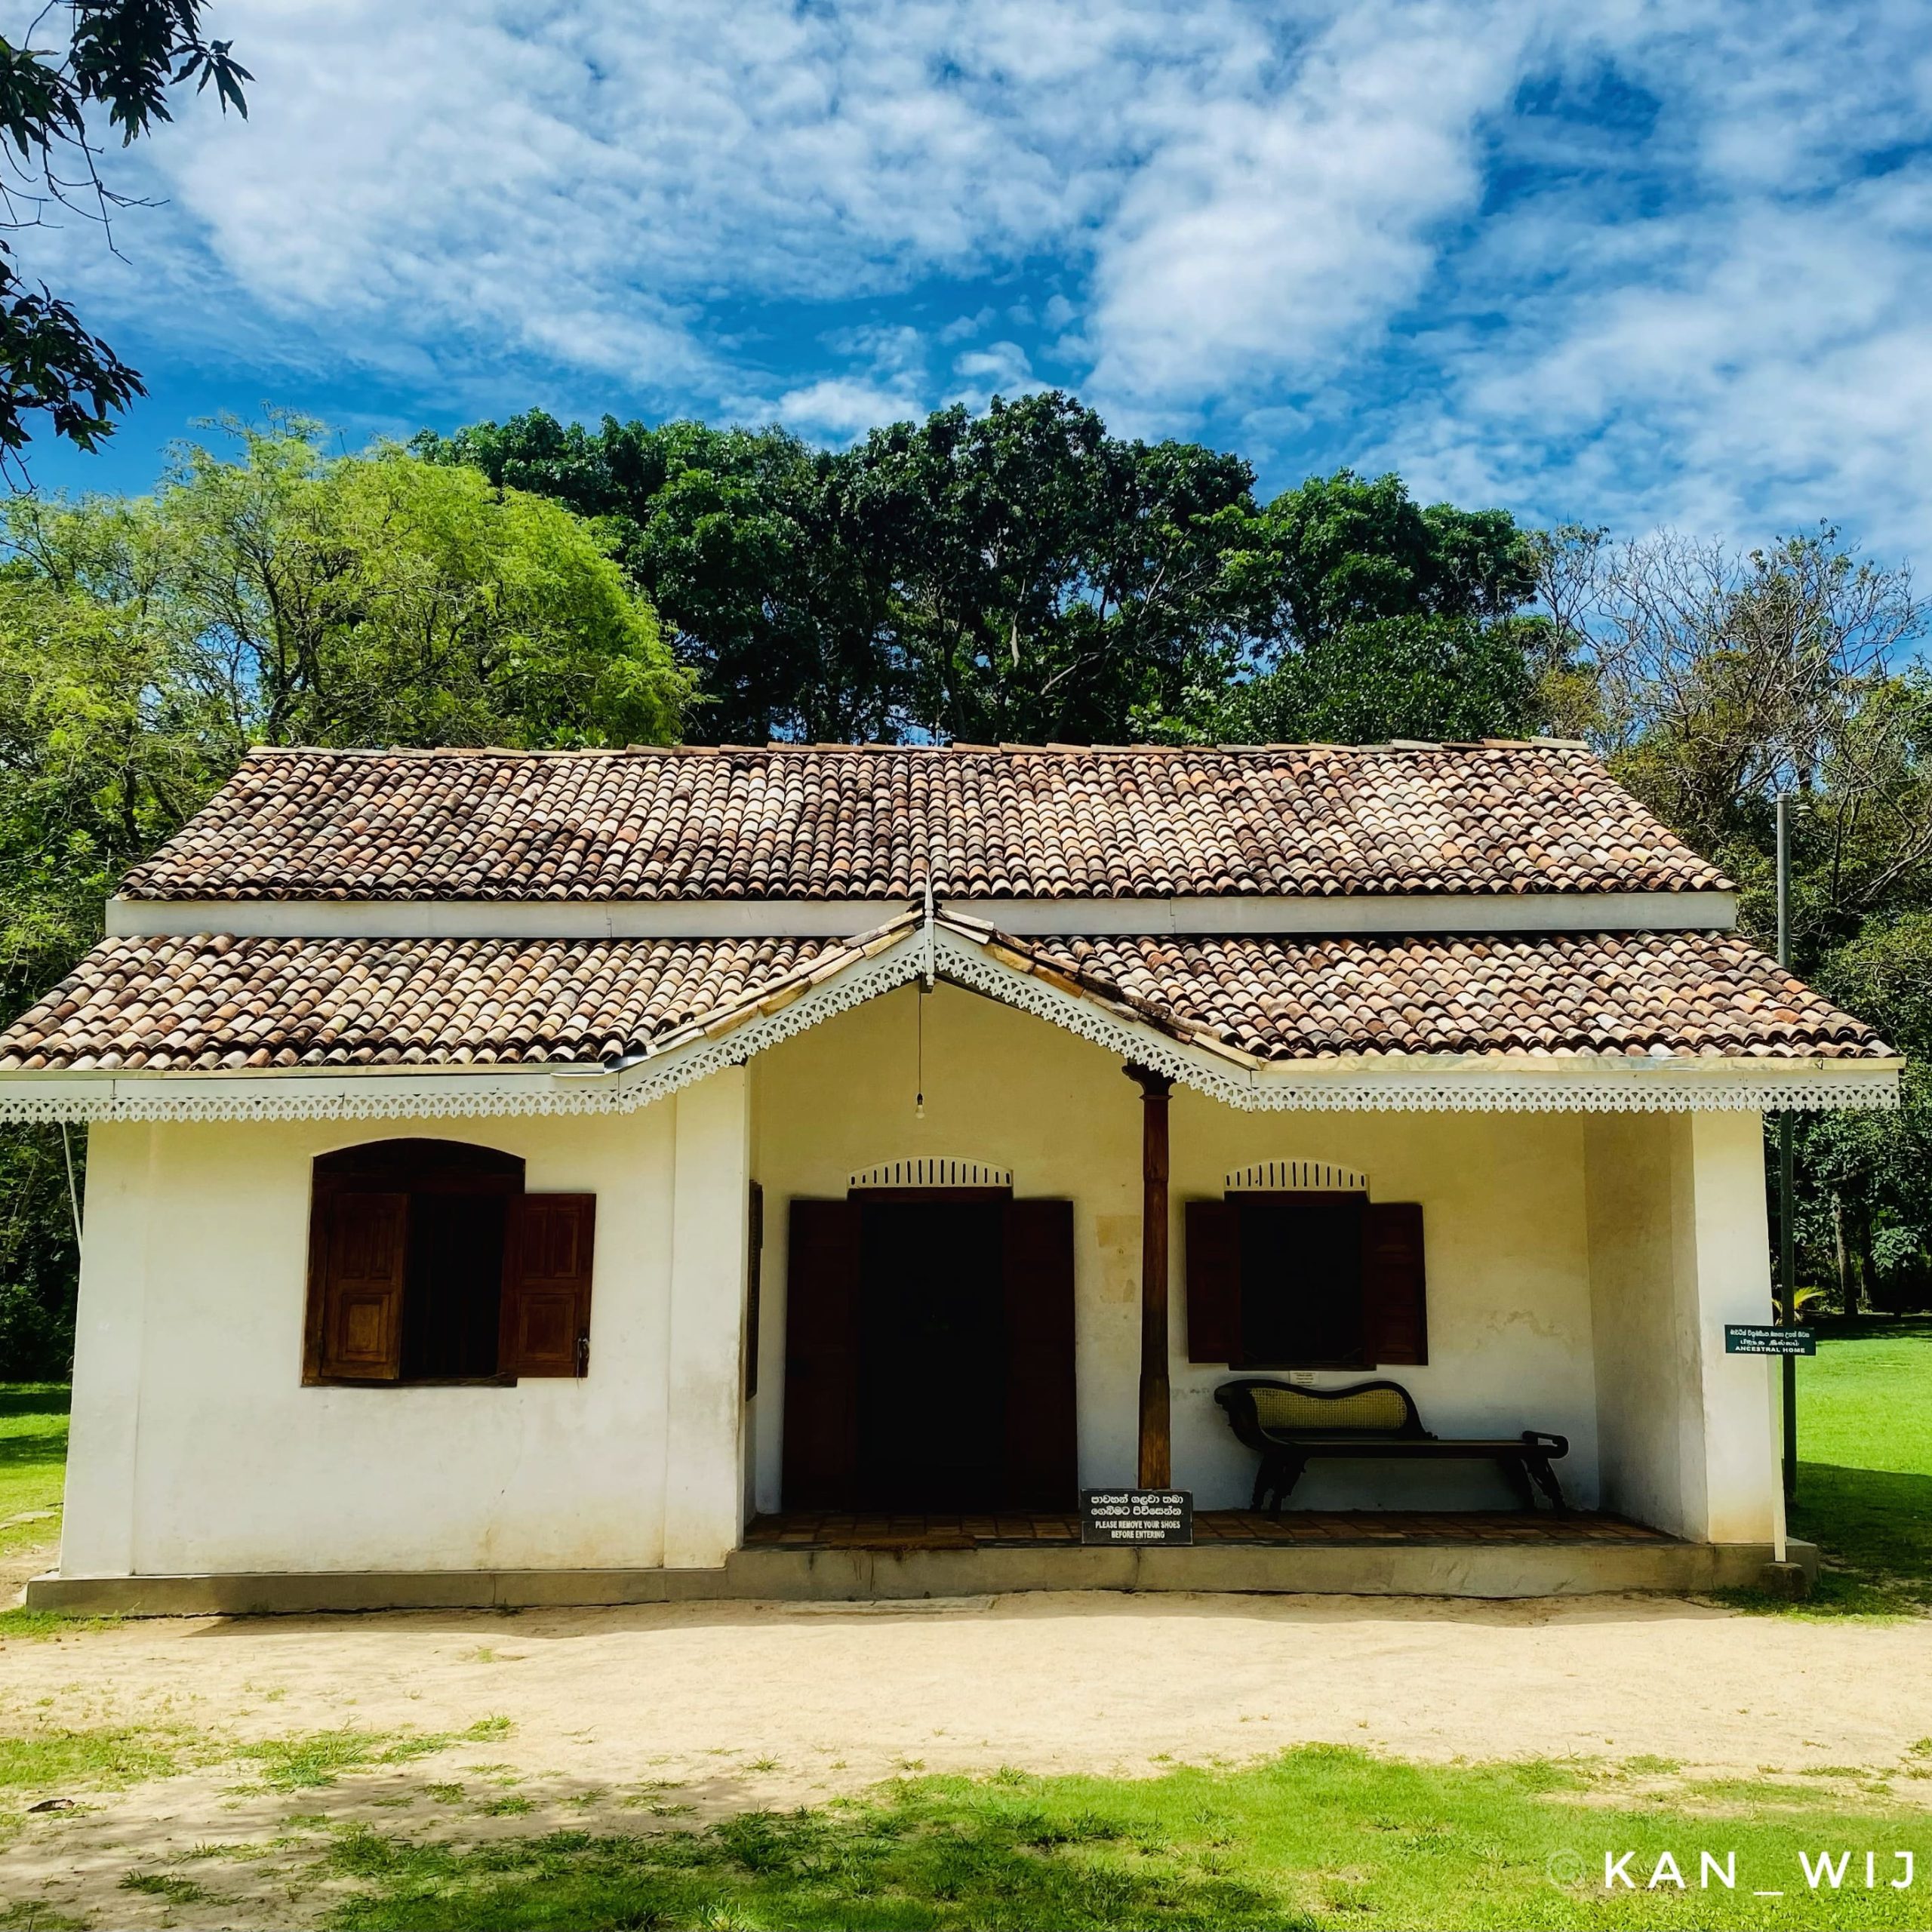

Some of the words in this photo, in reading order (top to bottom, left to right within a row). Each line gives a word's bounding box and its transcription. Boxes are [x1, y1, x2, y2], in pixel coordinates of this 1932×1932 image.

[1091, 1494, 1129, 1504] පාවහන්
[1131, 1494, 1160, 1505] ගලවා
[1162, 1494, 1184, 1504] තබා
[1095, 1521, 1118, 1529] PLEASE
[1118, 1521, 1143, 1529] REMOVE
[1143, 1521, 1160, 1529] YOUR
[1161, 1521, 1181, 1529] SHOES
[1111, 1531, 1135, 1539] BEFORE
[1135, 1531, 1165, 1539] ENTERING
